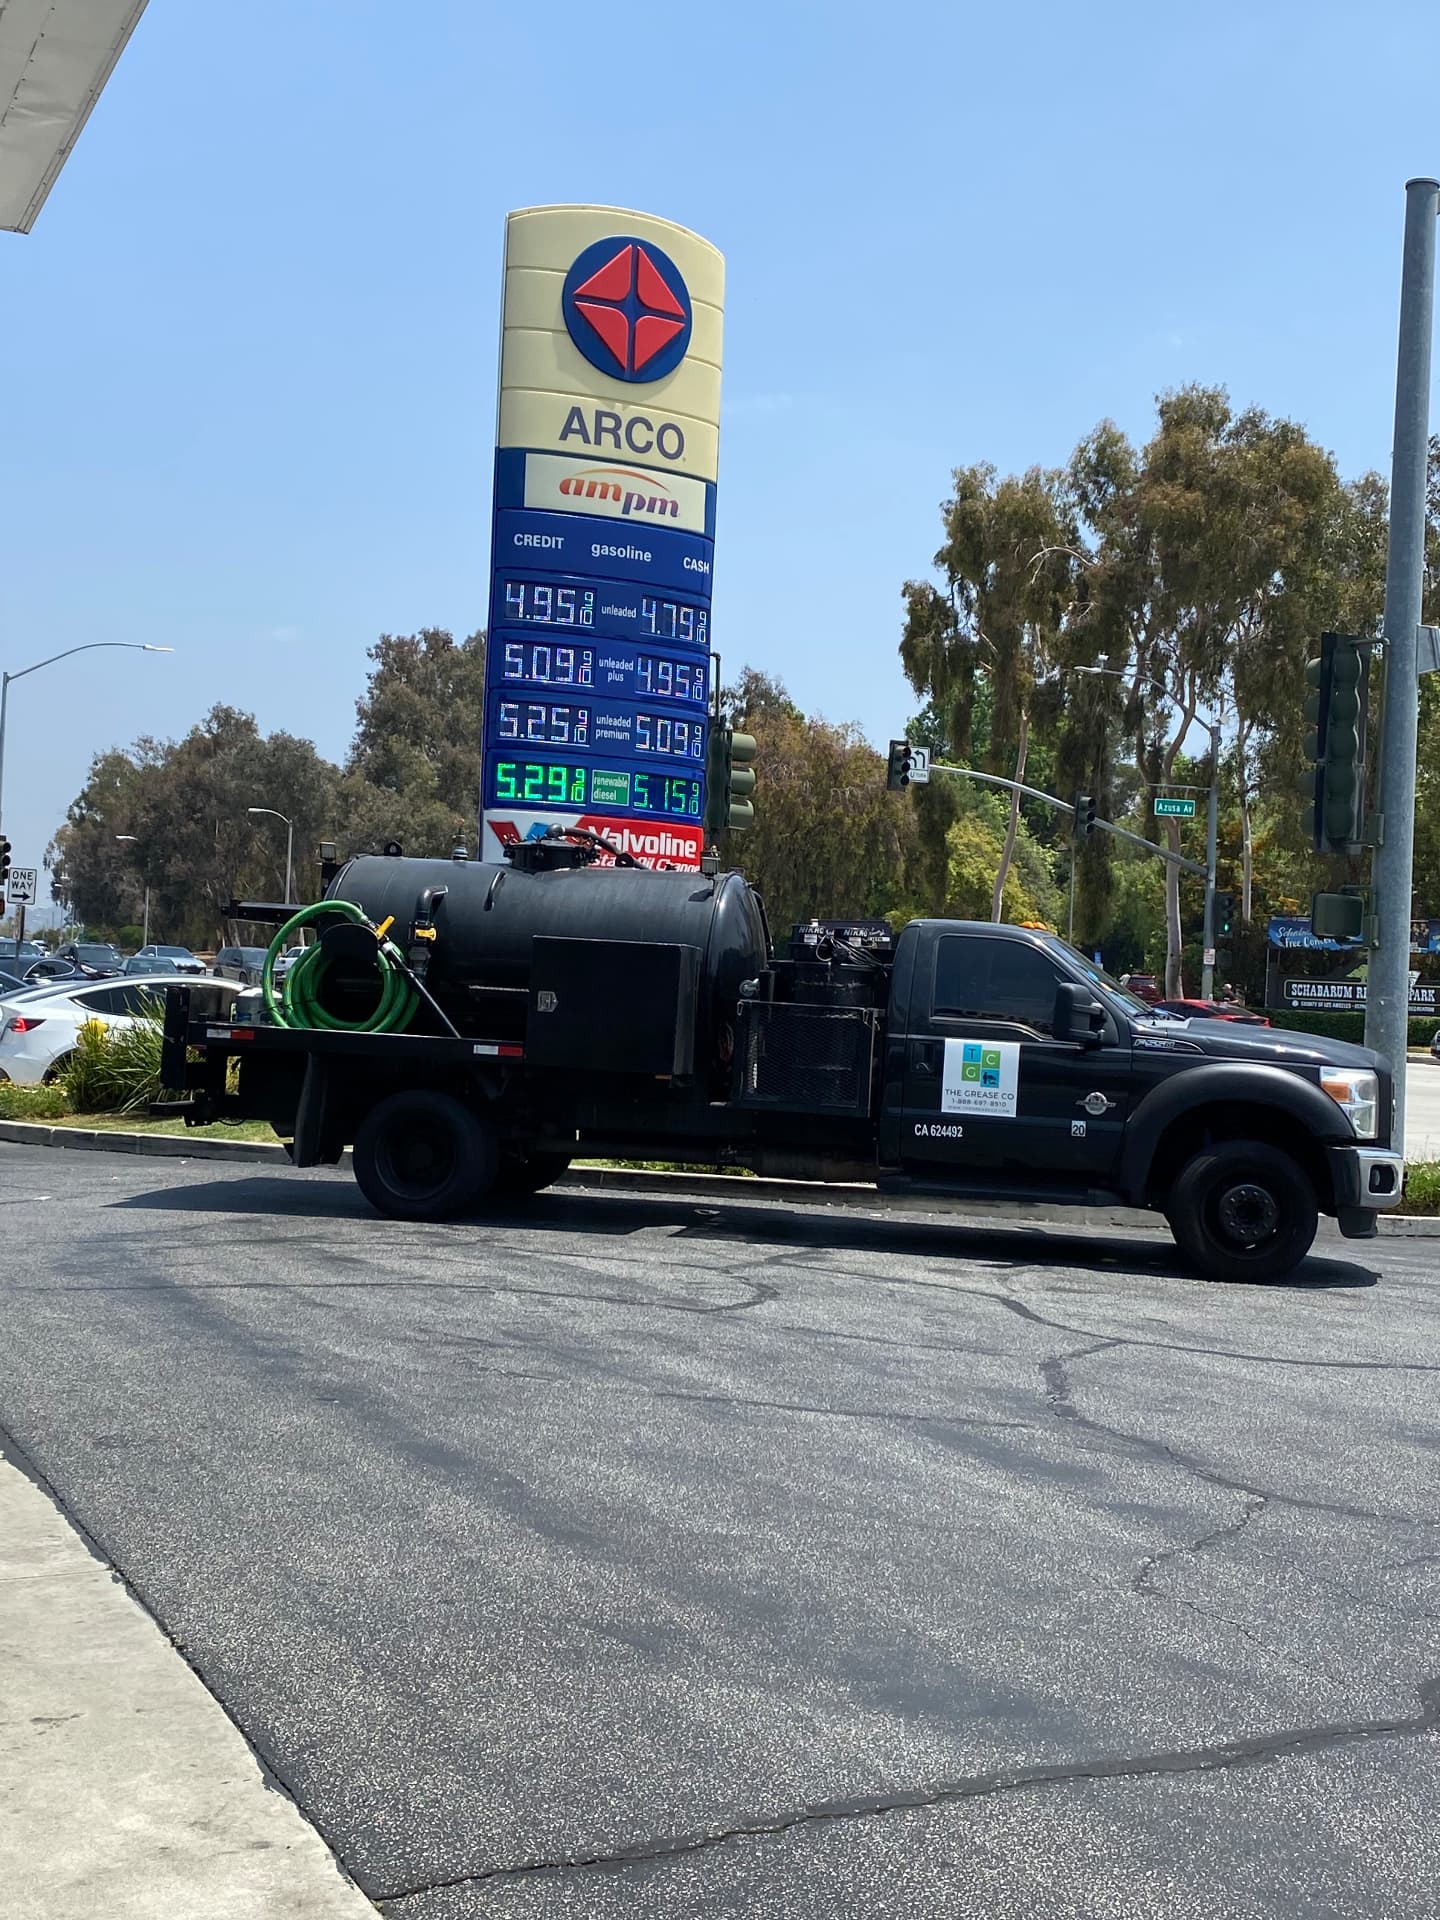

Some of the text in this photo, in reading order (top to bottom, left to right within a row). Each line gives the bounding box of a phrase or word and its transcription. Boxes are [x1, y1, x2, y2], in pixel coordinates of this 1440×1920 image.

[559, 406, 685, 460] ARCO
[559, 478, 679, 517] ampm
[514, 534, 564, 549] CREDIT
[591, 543, 652, 562] gasoline
[684, 557, 710, 574] CASH
[601, 604, 637, 618] unleaded
[599, 658, 634, 671] unleaded
[607, 669, 624, 683] plus
[596, 715, 632, 728] unleaded
[595, 728, 630, 741] premium
[593, 775, 629, 789] renewable
[593, 789, 617, 801] diesel
[1158, 802, 1181, 813] Azusa
[588, 825, 697, 859] Valvoline
[12, 870, 34, 881] ONE
[11, 881, 33, 890] WAY
[1291, 983, 1353, 999] SCHABARUM
[1408, 988, 1436, 1002] PARK
[968, 1048, 976, 1059] T
[986, 1054, 996, 1065] C
[966, 1067, 976, 1078] G
[945, 1089, 961, 1097] THE
[964, 1090, 999, 1099] GREASE
[914, 1123, 963, 1138] CA 624492
[1072, 1124, 1085, 1136] 20
